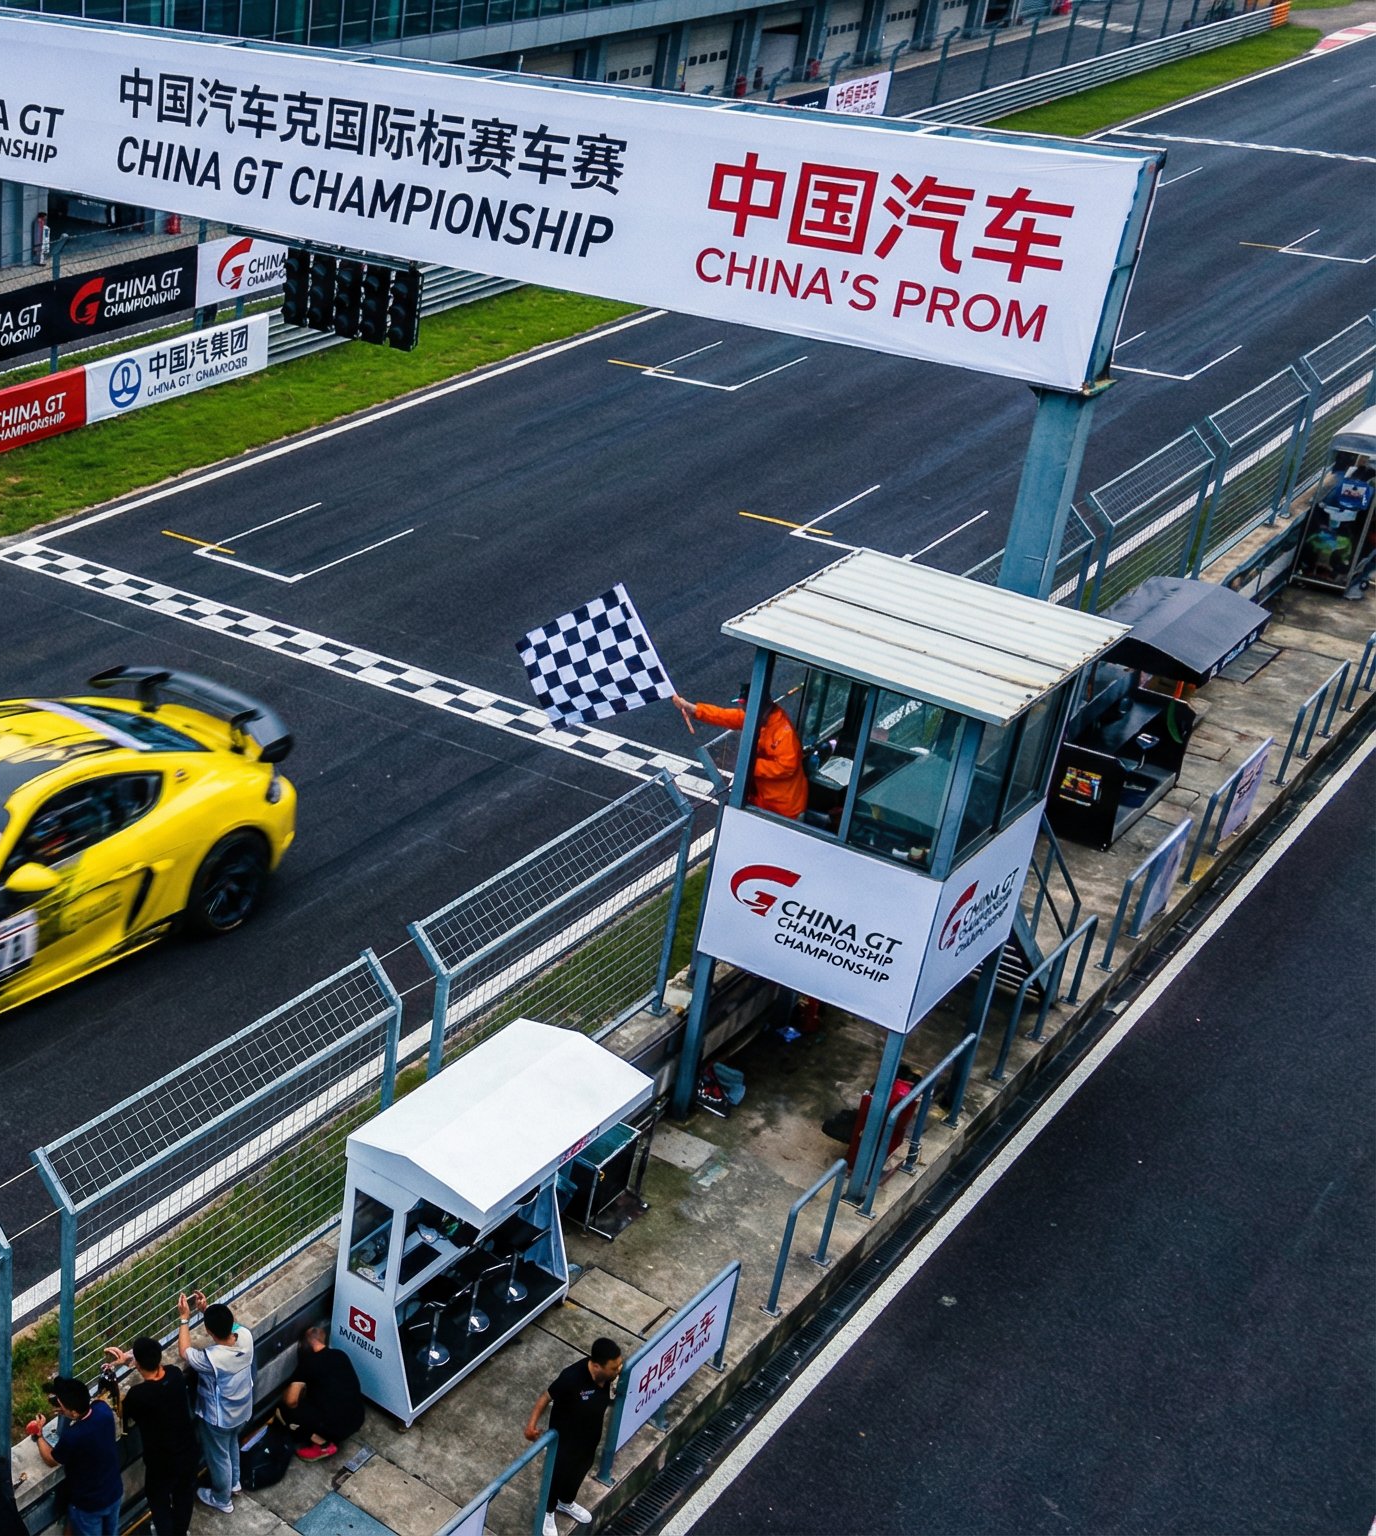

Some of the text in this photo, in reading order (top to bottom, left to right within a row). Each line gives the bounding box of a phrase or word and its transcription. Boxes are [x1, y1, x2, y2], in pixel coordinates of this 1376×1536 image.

[19, 104, 65, 139] GT
[119, 67, 628, 196] 中国汽车克国际标赛车赛
[117, 135, 614, 258] CHINA GT CHAMPIONSHIP
[707, 151, 1075, 283] 中国汽车
[104, 267, 183, 303] CHINA GT
[695, 247, 1048, 343] CHINA'S PROM
[18, 303, 42, 326] GT
[149, 324, 249, 379] 中国汽集团
[45, 391, 67, 413] GT
[777, 917, 894, 967] CHAMPIONSHIP
[781, 900, 903, 955] CHINA GT
[774, 933, 890, 983] CHAMPIONSHIP
